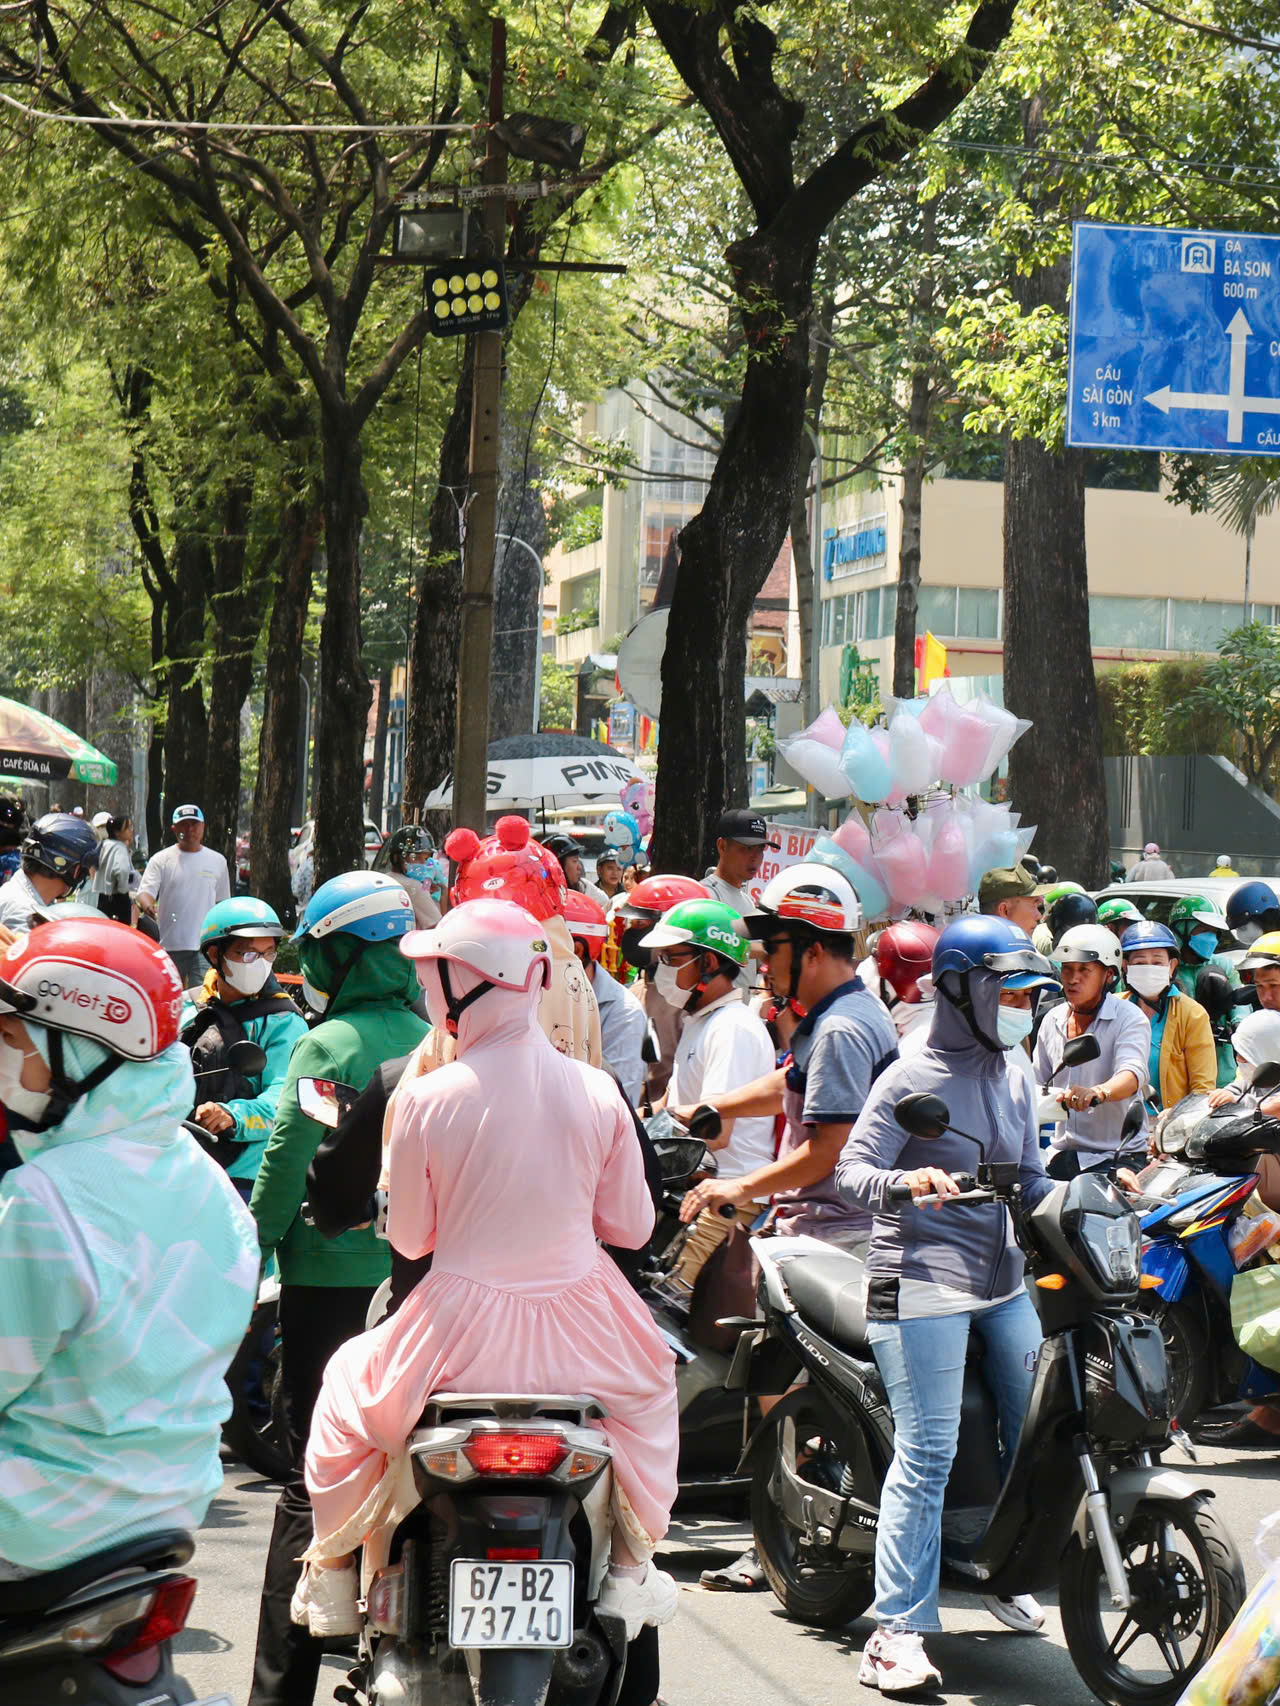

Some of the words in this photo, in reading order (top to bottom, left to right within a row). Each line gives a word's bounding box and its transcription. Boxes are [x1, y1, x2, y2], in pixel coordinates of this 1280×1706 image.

[1225, 240, 1242, 253] GA
[1224, 260, 1241, 276] BA
[1243, 261, 1272, 278] SON
[1223, 282, 1245, 298] 600
[1246, 287, 1258, 299] m
[1082, 384, 1104, 404] SÀI
[1106, 385, 1133, 406] GÒN
[1092, 411, 1100, 427] 3
[1101, 411, 1121, 428] km
[561, 761, 633, 787] PING
[706, 926, 740, 947] Grab
[796, 1331, 830, 1367] LUDO
[1086, 1352, 1114, 1369] VINFAST
[858, 1515, 877, 1527] VINF
[470, 1567, 554, 1602] 67-B2
[460, 1606, 562, 1642] 737.40
